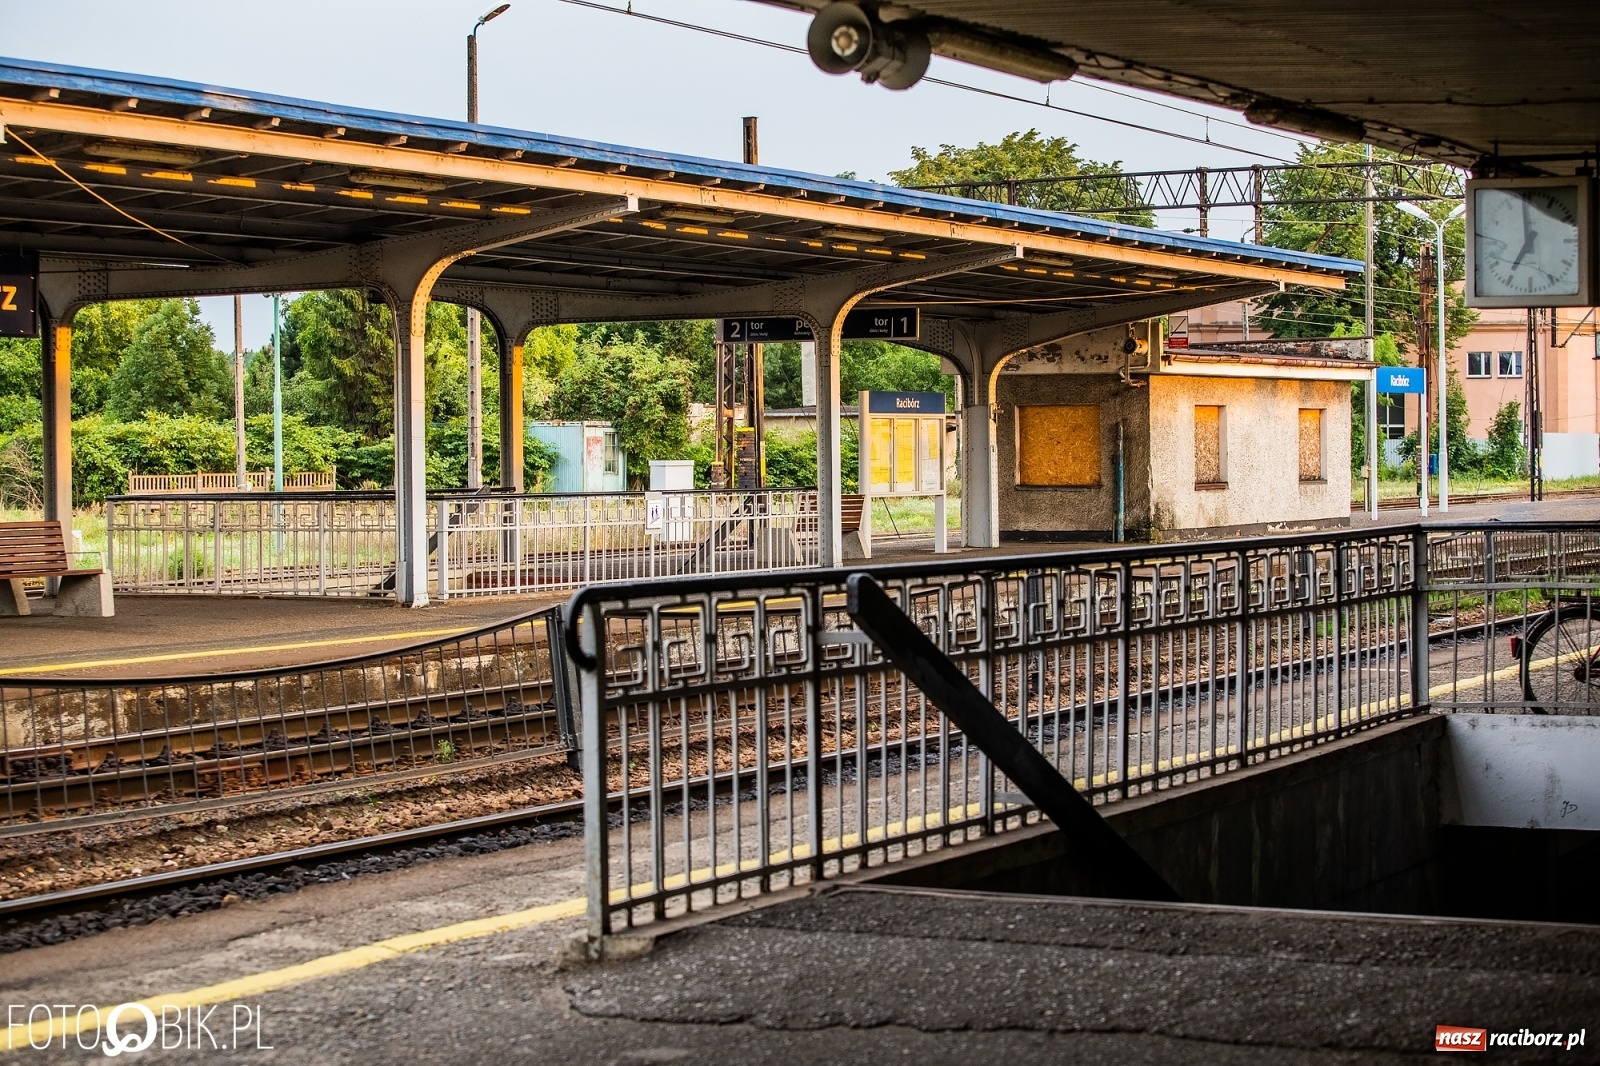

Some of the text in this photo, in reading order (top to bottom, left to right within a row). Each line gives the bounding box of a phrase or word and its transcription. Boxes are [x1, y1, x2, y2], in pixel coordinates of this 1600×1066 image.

[730, 321, 741, 338] 2
[750, 321, 764, 330] tor
[874, 317, 889, 326] tor
[900, 316, 908, 334] 1
[896, 397, 920, 409] Racibórz
